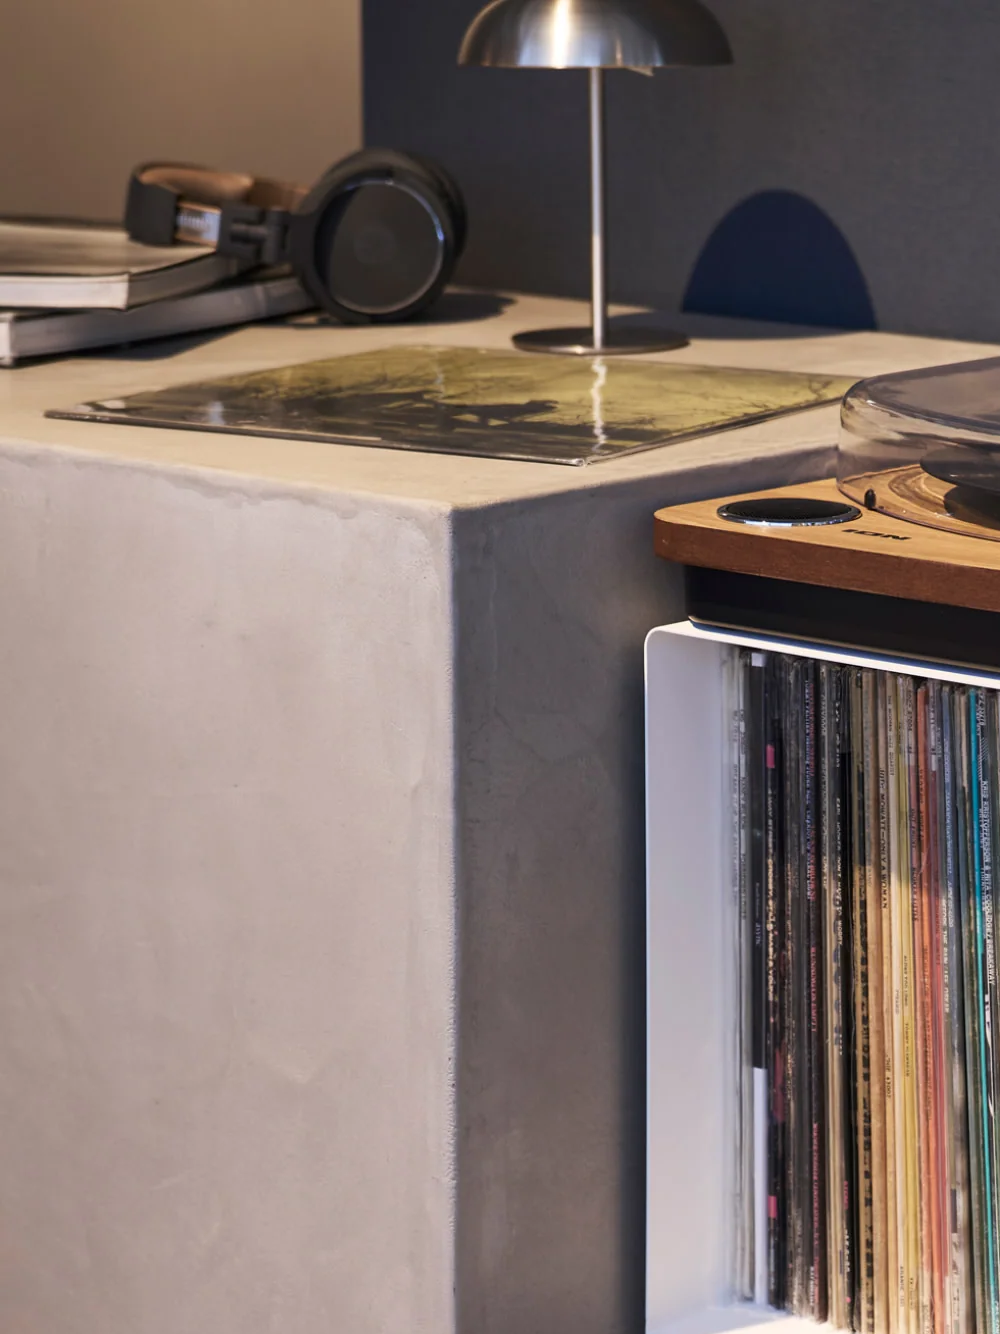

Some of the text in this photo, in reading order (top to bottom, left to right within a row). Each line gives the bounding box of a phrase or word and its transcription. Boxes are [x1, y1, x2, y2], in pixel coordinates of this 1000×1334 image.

[982, 780, 990, 800] KRIS
[982, 802, 991, 863] KRISTOFFERSON
[881, 873, 889, 909] WOMAN
